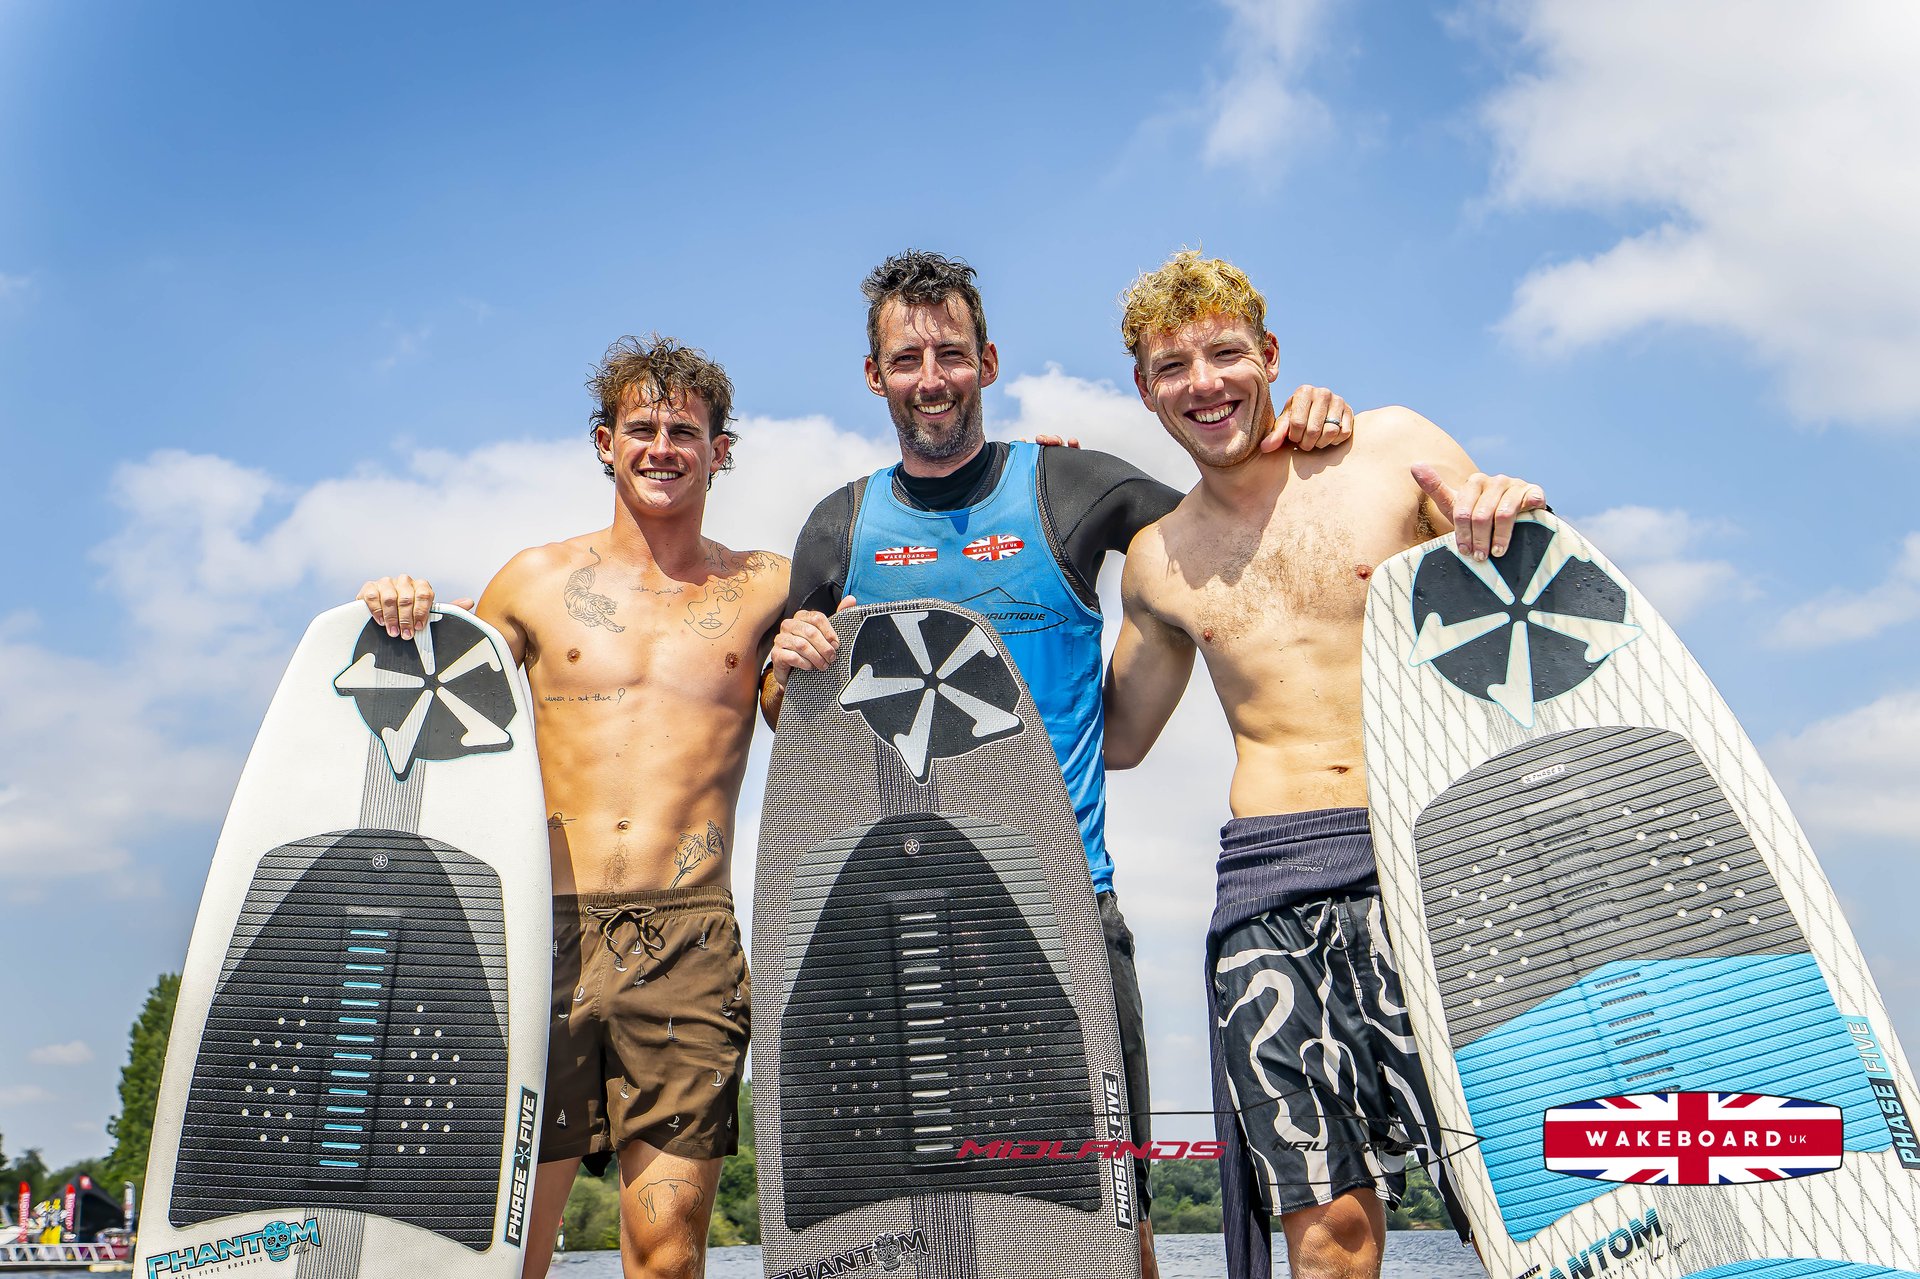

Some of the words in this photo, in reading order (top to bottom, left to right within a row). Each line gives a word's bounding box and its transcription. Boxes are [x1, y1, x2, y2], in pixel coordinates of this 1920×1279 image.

[972, 544, 1008, 554] WAKESURF
[1847, 1021, 1887, 1074] FIVE
[1104, 1077, 1122, 1127] FIVE
[1872, 1084, 1920, 1164] PHASE
[508, 1166, 528, 1240] PHASE
[519, 1095, 536, 1144] FIVE
[1112, 1152, 1131, 1225] PHASE
